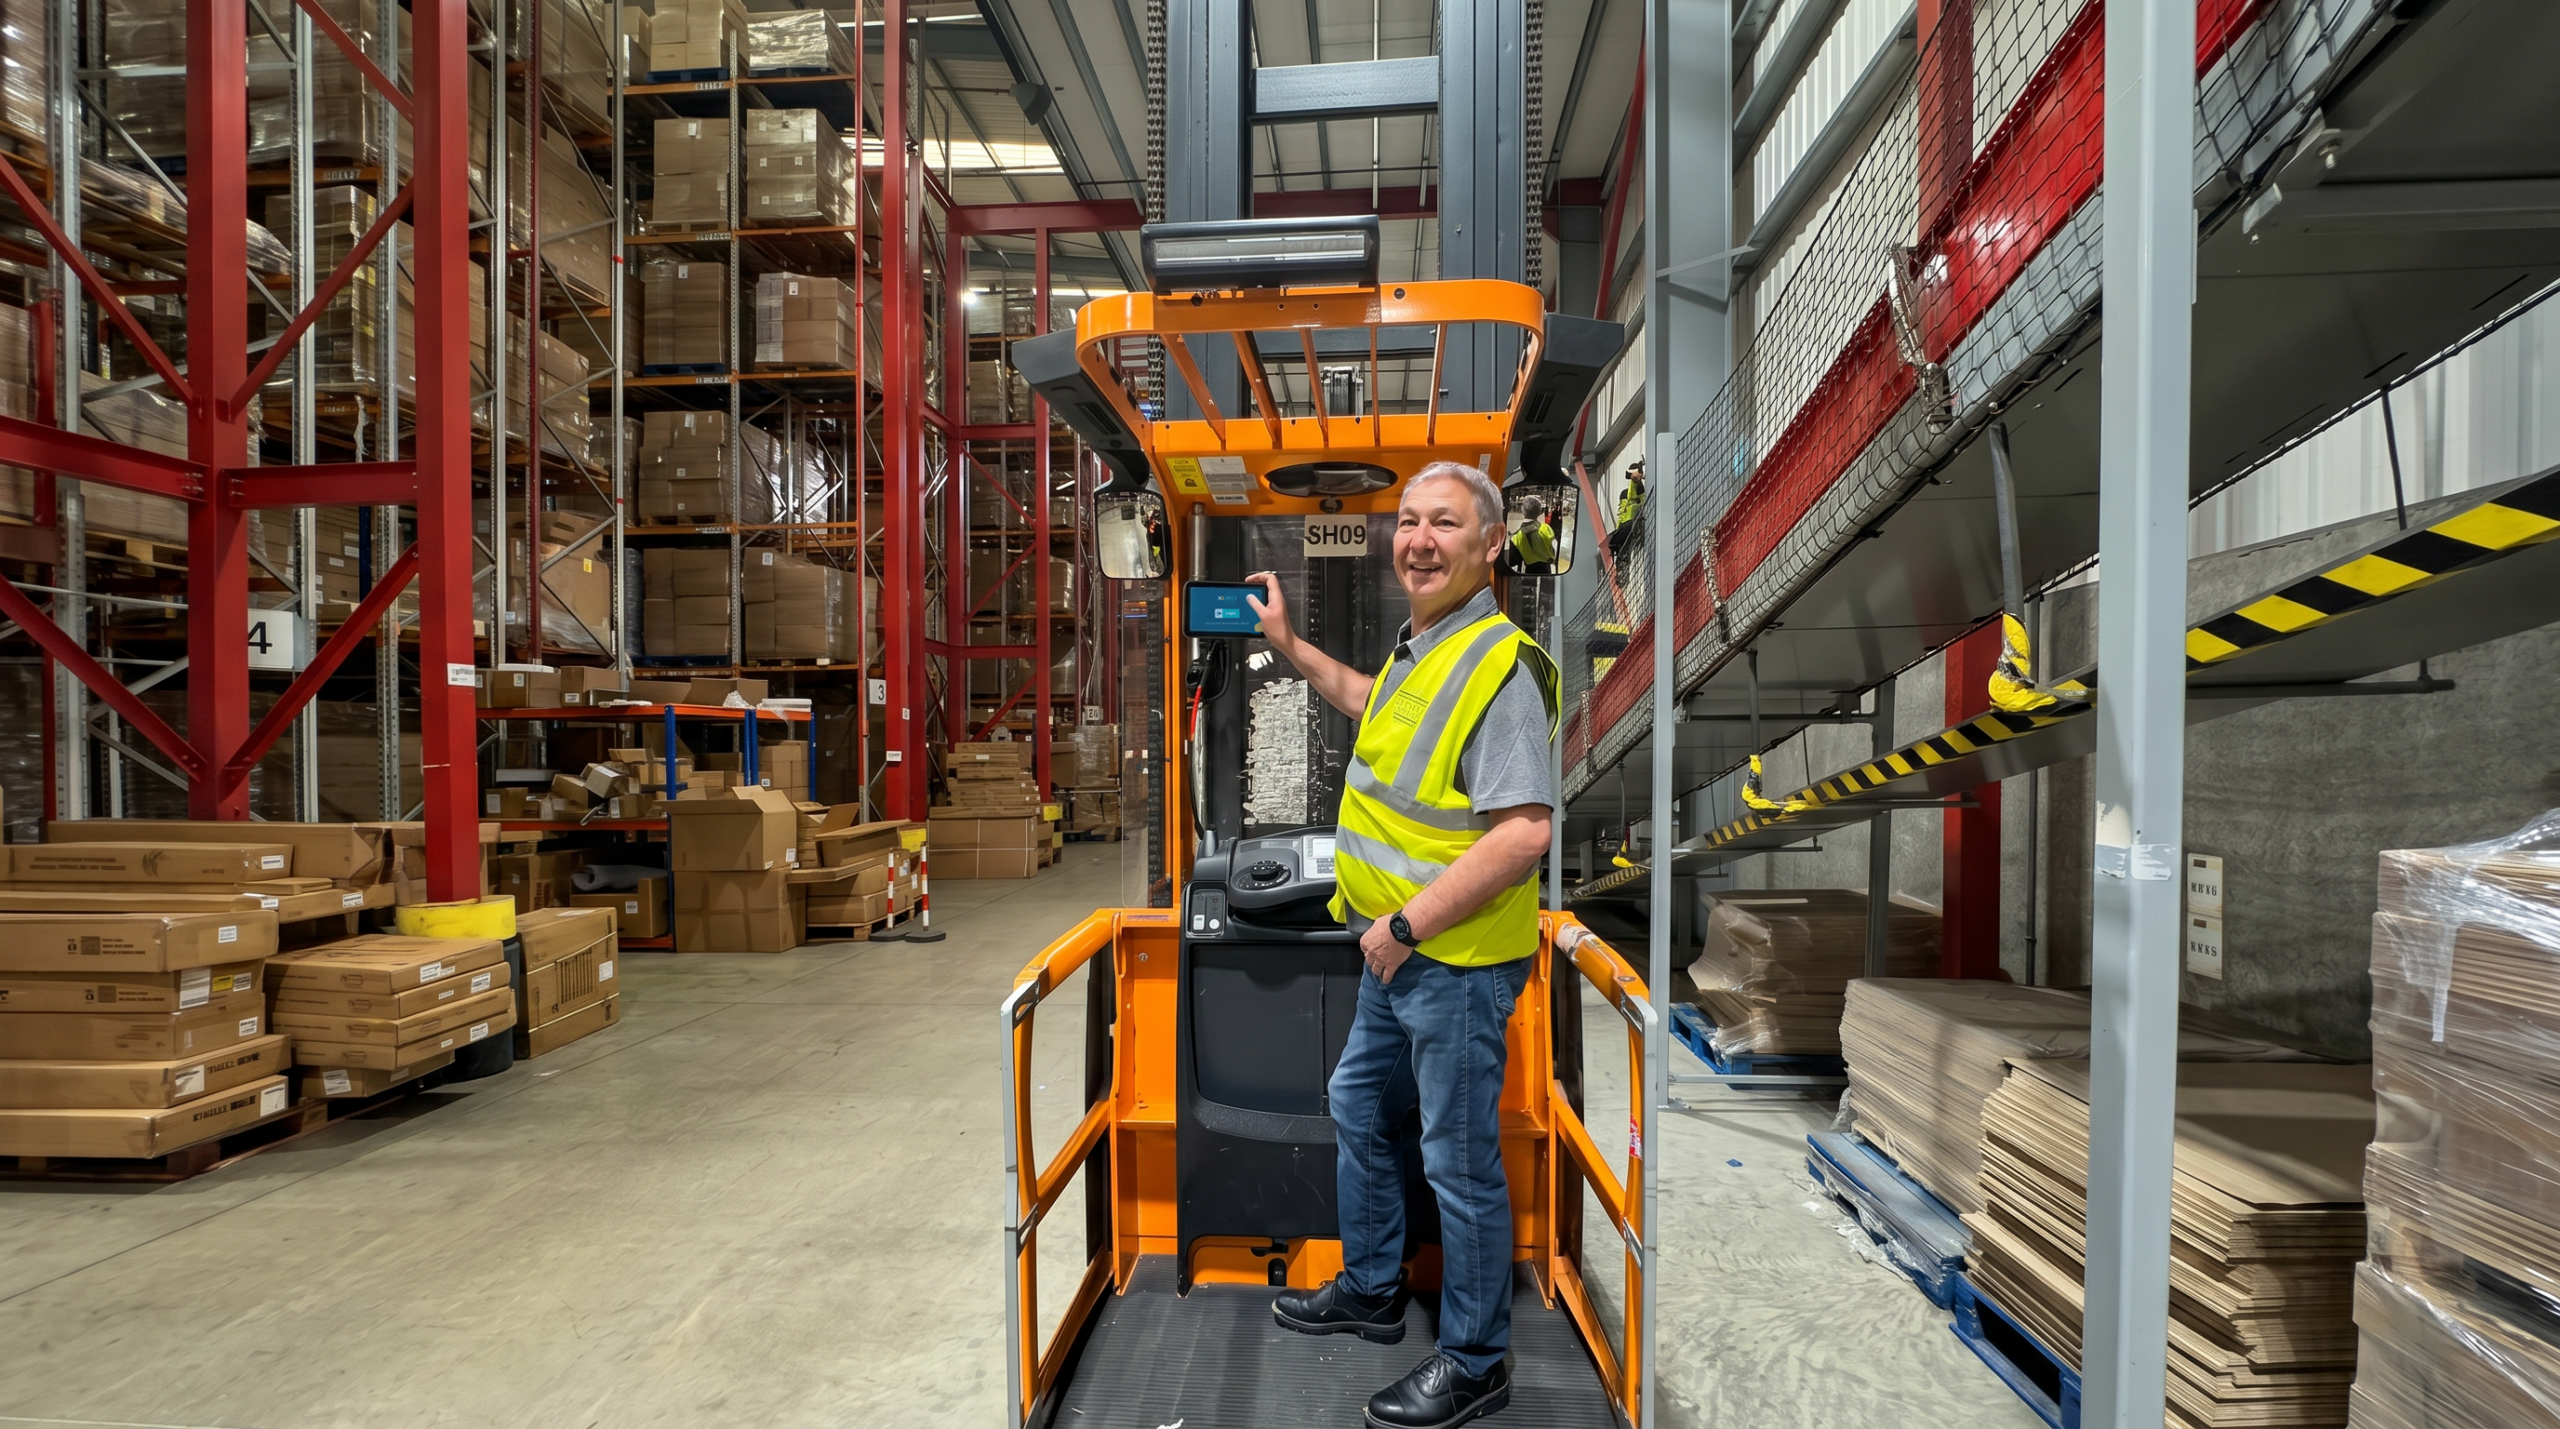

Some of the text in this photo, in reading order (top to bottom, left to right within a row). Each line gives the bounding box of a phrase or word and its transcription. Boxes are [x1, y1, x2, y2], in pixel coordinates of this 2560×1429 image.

[1305, 524, 1366, 546] SH09
[248, 621, 273, 655] 4
[878, 684, 885, 701] 3
